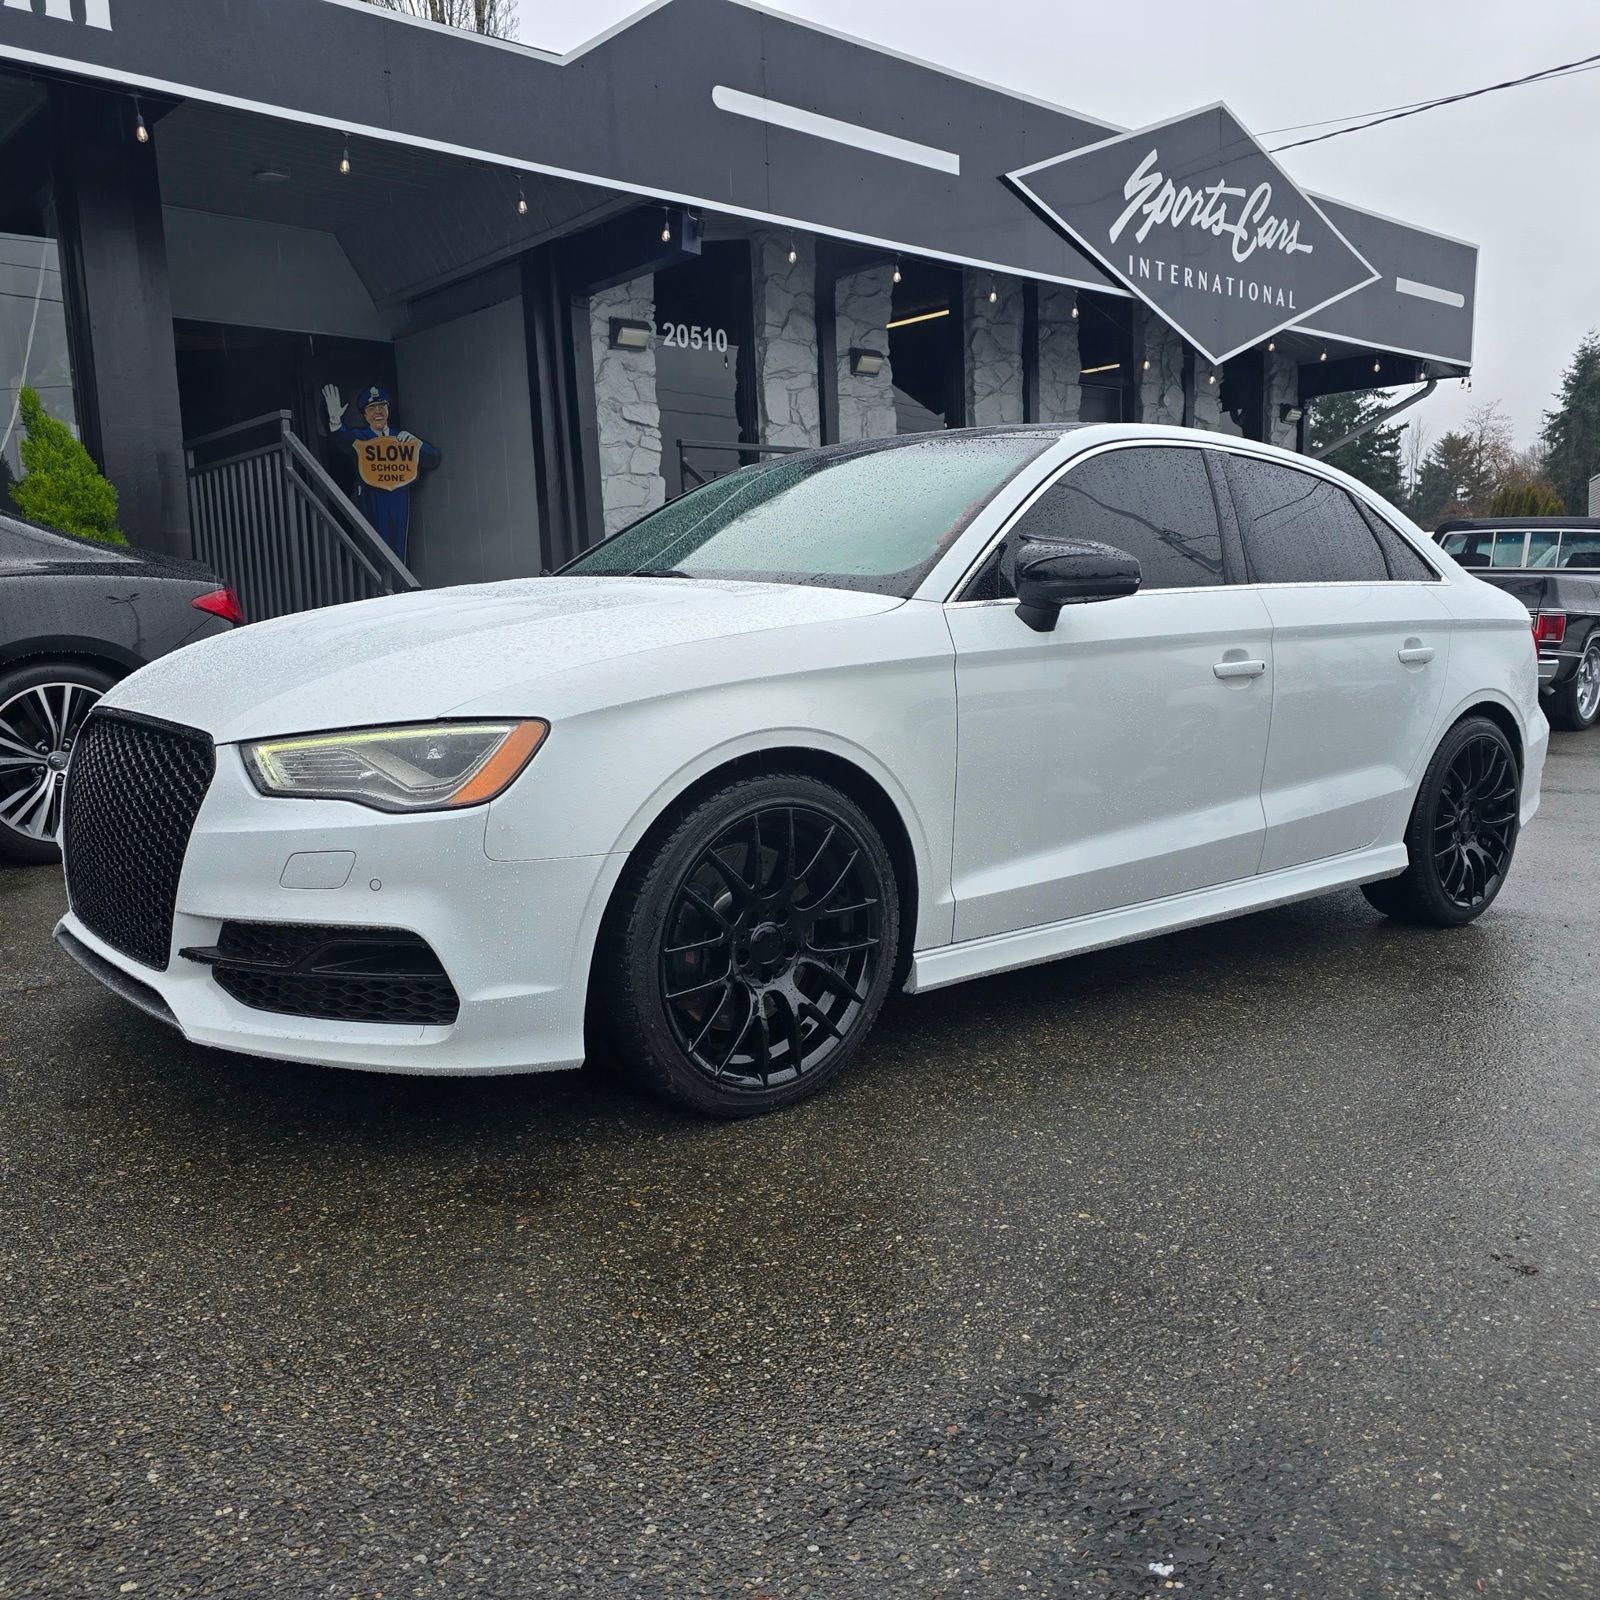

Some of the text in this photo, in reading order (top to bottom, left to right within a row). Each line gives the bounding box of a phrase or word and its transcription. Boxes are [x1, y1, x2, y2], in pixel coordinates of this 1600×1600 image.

[1109, 148, 1313, 263] Sports Cars
[1128, 254, 1297, 310] INTERNATIONAL
[662, 322, 728, 353] 20510
[365, 445, 415, 462] SLOW
[370, 463, 412, 472] SCHOOL
[377, 474, 406, 482] ZONE
